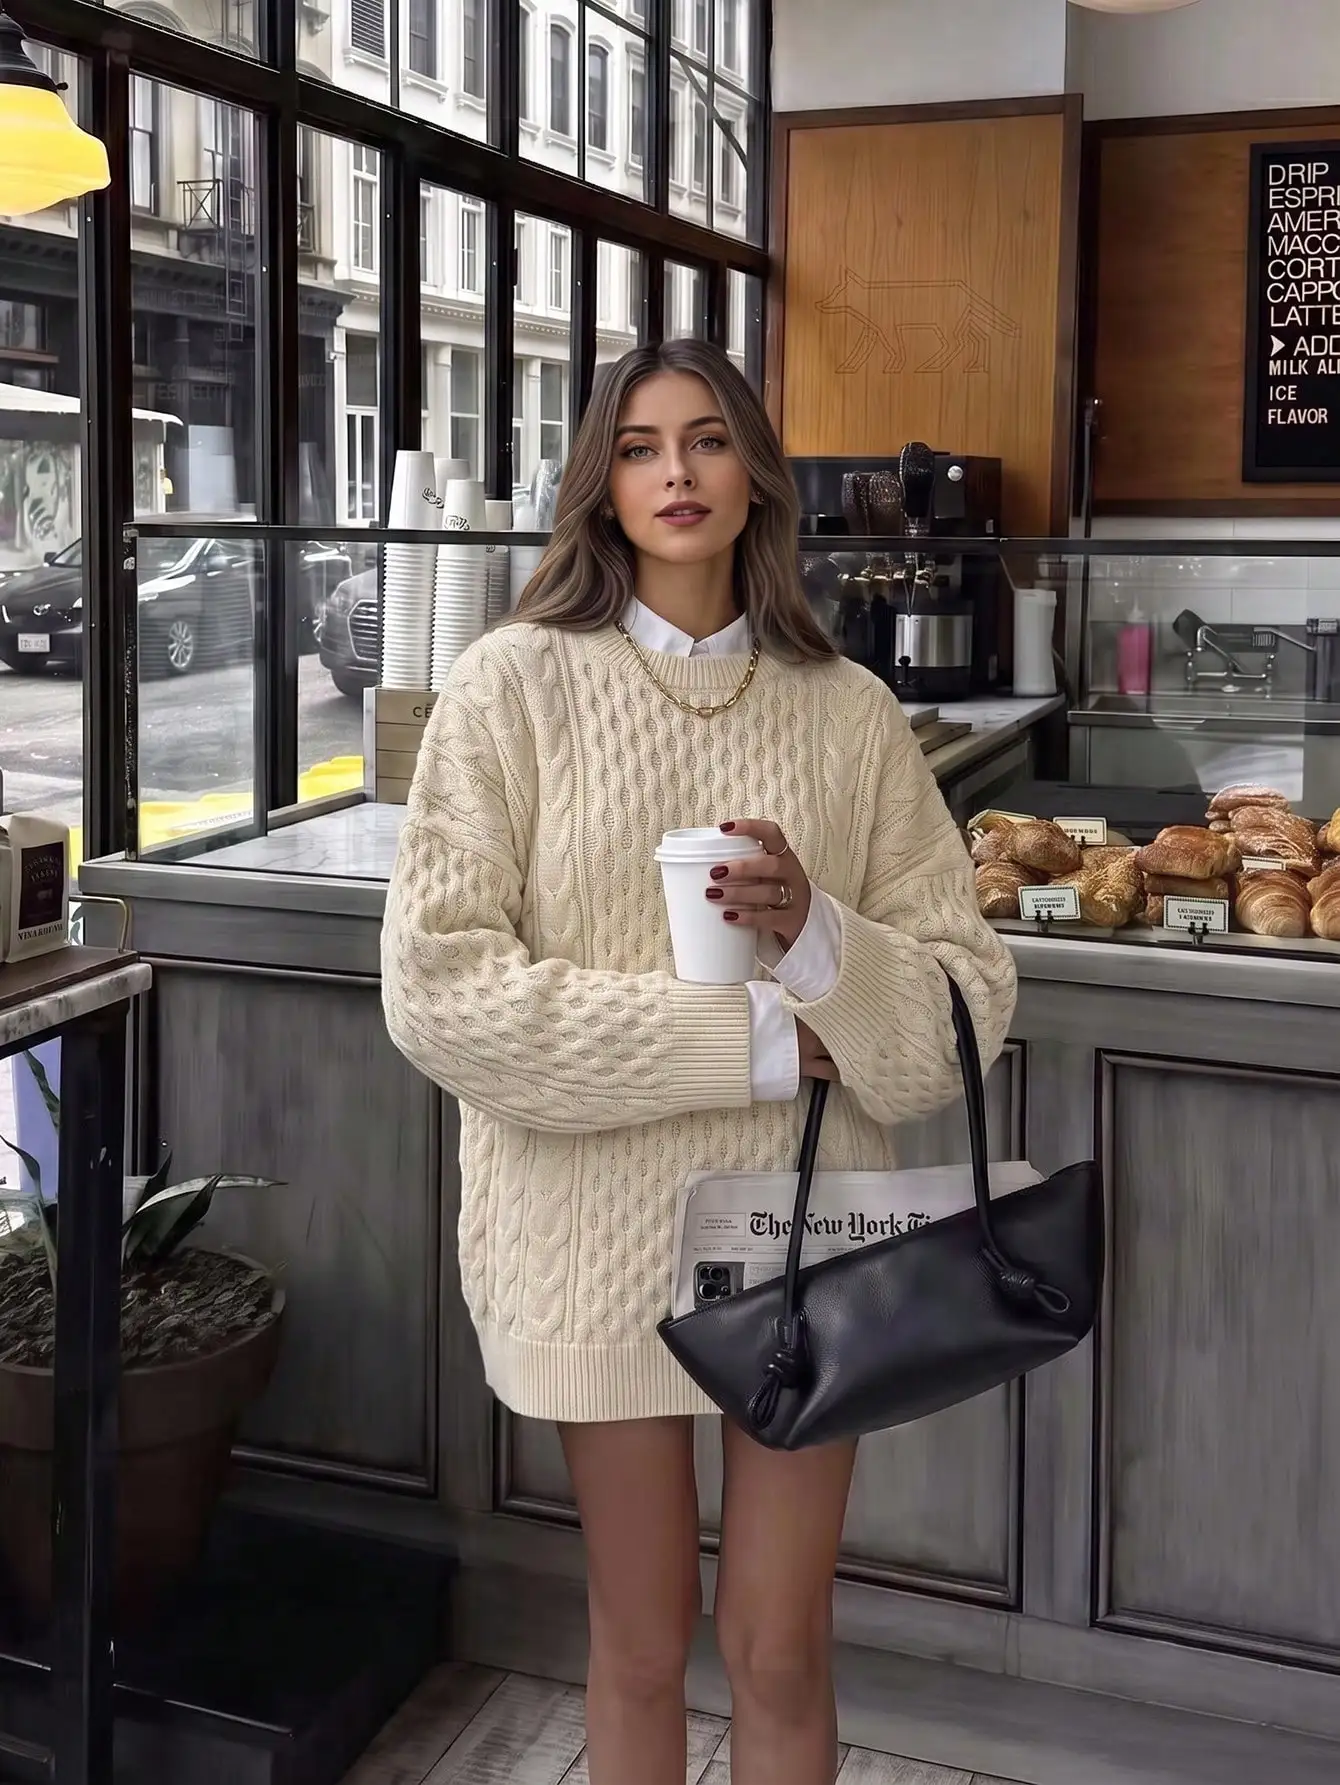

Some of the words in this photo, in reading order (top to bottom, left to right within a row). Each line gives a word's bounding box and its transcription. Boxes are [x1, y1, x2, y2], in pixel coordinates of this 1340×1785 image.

[1269, 162, 1329, 185] DRIP
[1269, 185, 1340, 208] ESPR
[1267, 210, 1340, 233] AMER
[1268, 234, 1340, 256] MACC
[1268, 257, 1340, 279] CORT
[1269, 359, 1309, 375] MILK
[1270, 385, 1297, 401] ICE
[1268, 408, 1328, 424] FLAVOR
[750, 1211, 792, 1239] The
[848, 1212, 902, 1243] York
